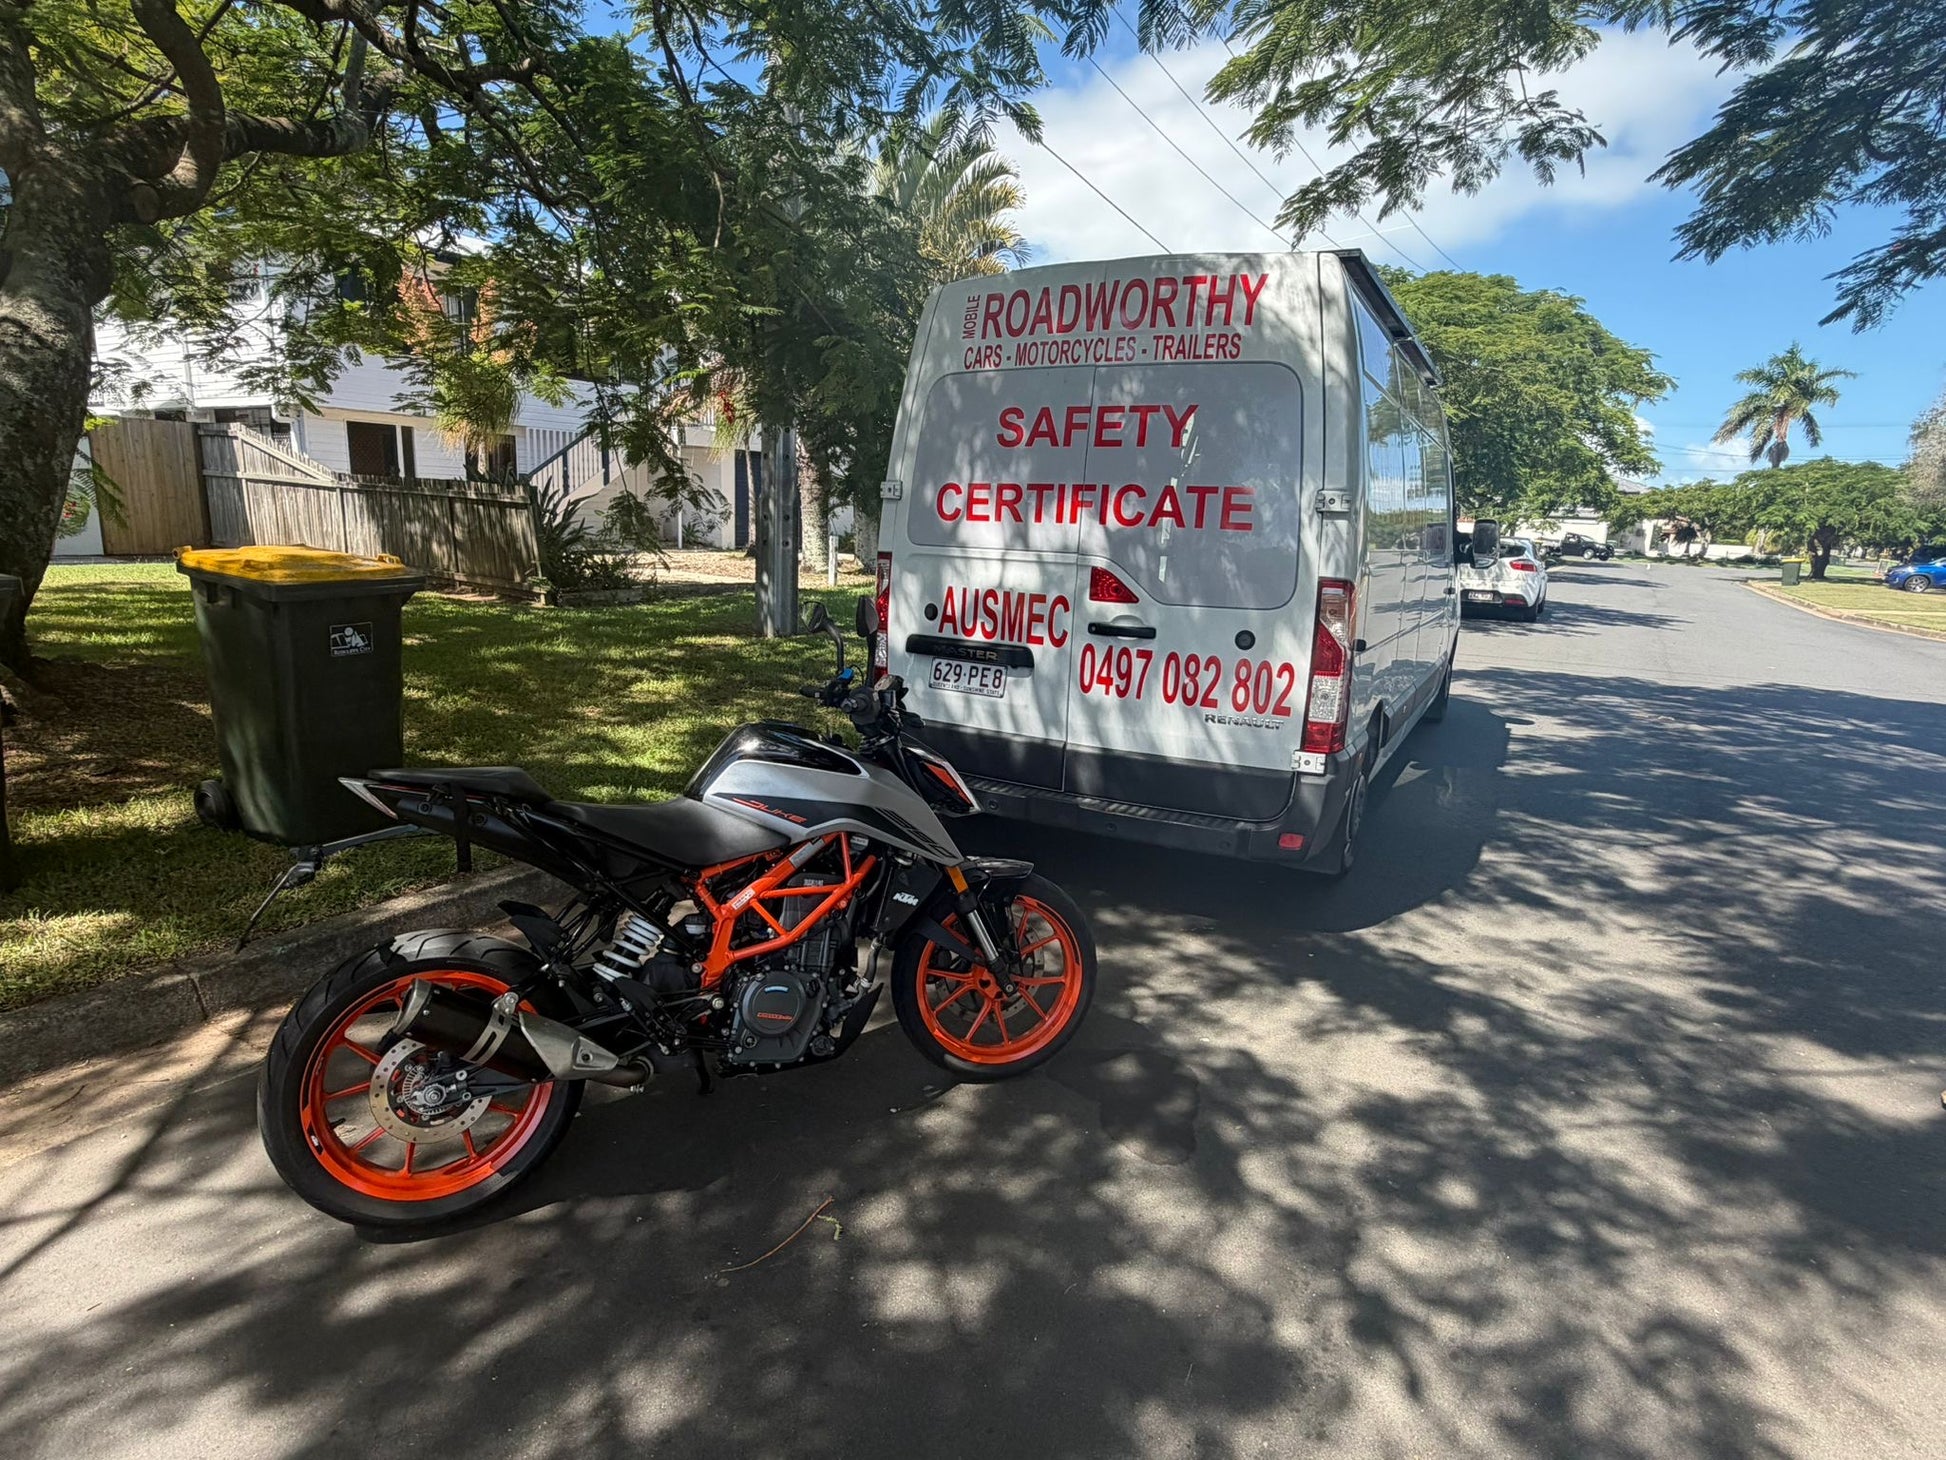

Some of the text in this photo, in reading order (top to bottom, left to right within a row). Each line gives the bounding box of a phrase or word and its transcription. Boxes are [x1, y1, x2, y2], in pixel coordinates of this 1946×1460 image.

[962, 294, 981, 340] MOBILE
[981, 273, 1269, 340] ROADWORTHY
[964, 344, 1003, 370] CARS
[1014, 336, 1137, 367] MOTORCYCLES
[1153, 332, 1242, 361] TRAILERS
[996, 404, 1199, 449] SAFETY
[936, 481, 1257, 533] CERTIFICATE
[938, 586, 1071, 648] AUSMEC
[1078, 642, 1296, 718] 0497 082 802
[1204, 713, 1285, 730] RENAULT
[893, 892, 919, 906] KTM
